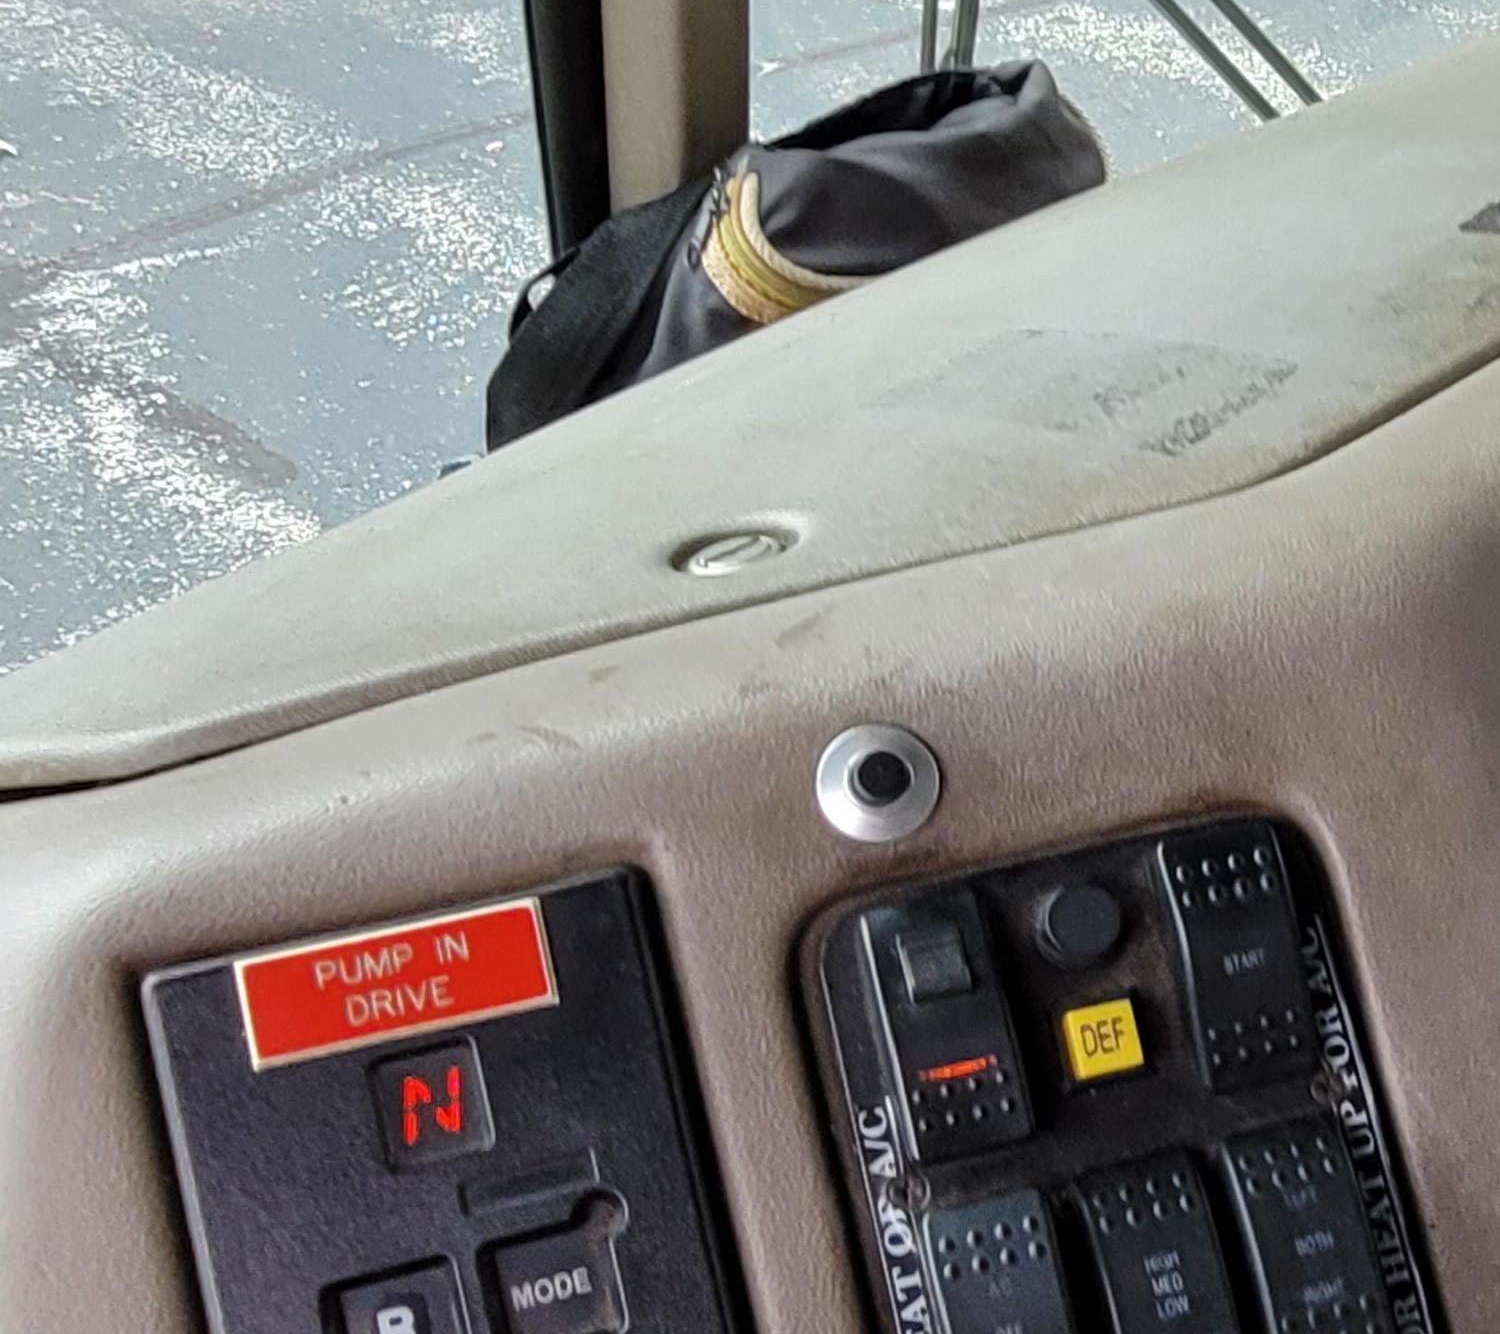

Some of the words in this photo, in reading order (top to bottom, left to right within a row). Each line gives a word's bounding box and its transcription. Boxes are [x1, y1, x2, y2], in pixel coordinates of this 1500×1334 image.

[313, 942, 414, 991] PUMP
[436, 930, 471, 965] IN
[1223, 947, 1265, 976] START
[345, 975, 456, 1028] DRIVE
[1079, 1017, 1126, 1058] DEF
[403, 1065, 464, 1147] N
[1341, 1098, 1375, 1159] UP
[858, 1105, 897, 1178] A/C
[1358, 1171, 1410, 1286] HEAT
[511, 1267, 593, 1313] MODE
[1151, 1271, 1184, 1297] MED
[1156, 1294, 1190, 1322] LOW
